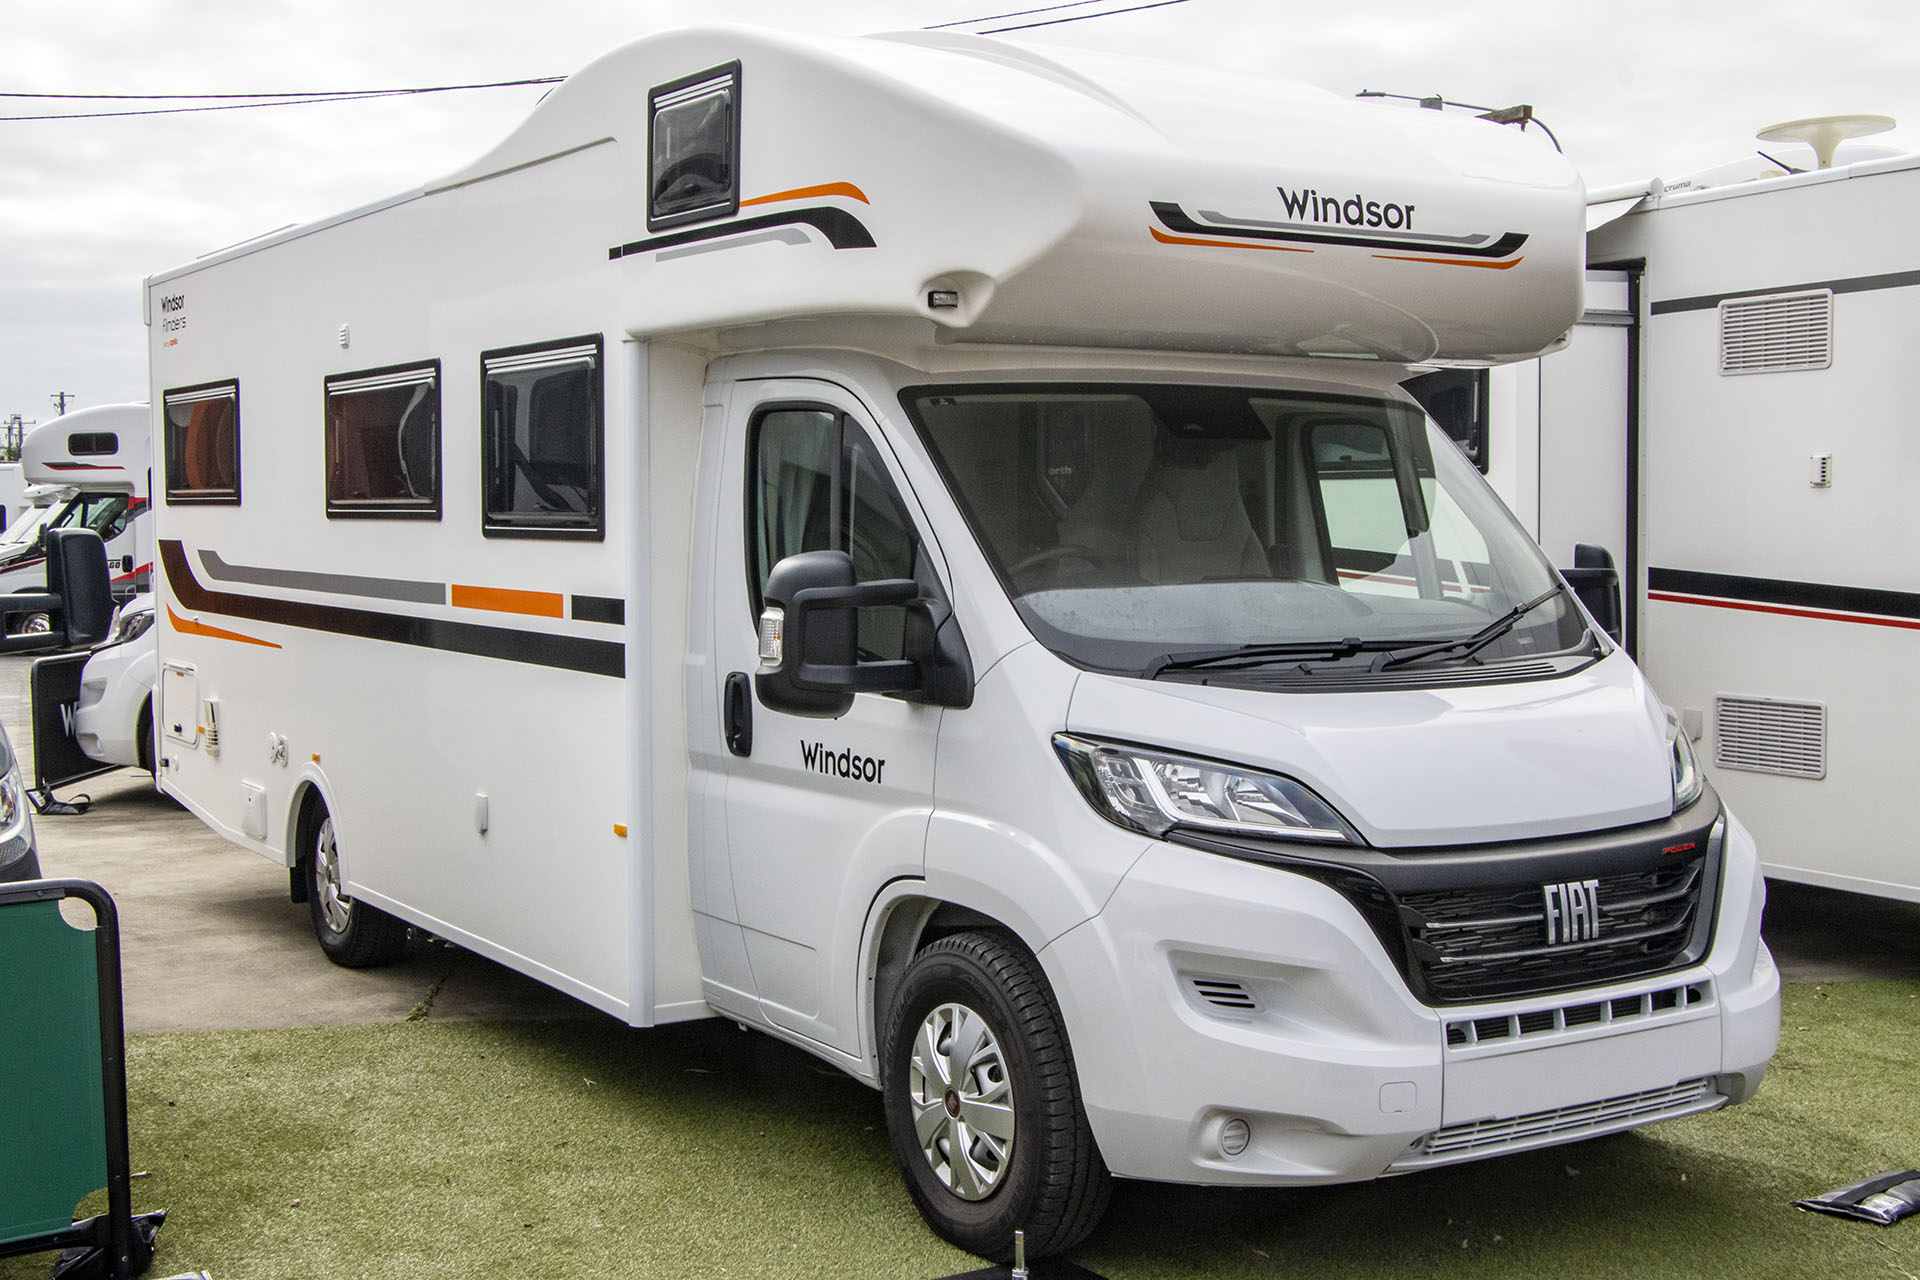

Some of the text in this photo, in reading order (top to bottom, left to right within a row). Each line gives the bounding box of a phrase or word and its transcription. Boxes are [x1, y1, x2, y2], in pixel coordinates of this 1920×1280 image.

[1277, 186, 1415, 230] Windsor
[161, 295, 184, 312] Windsor
[800, 740, 885, 784] Windsor
[1543, 879, 1600, 945] FIAT
